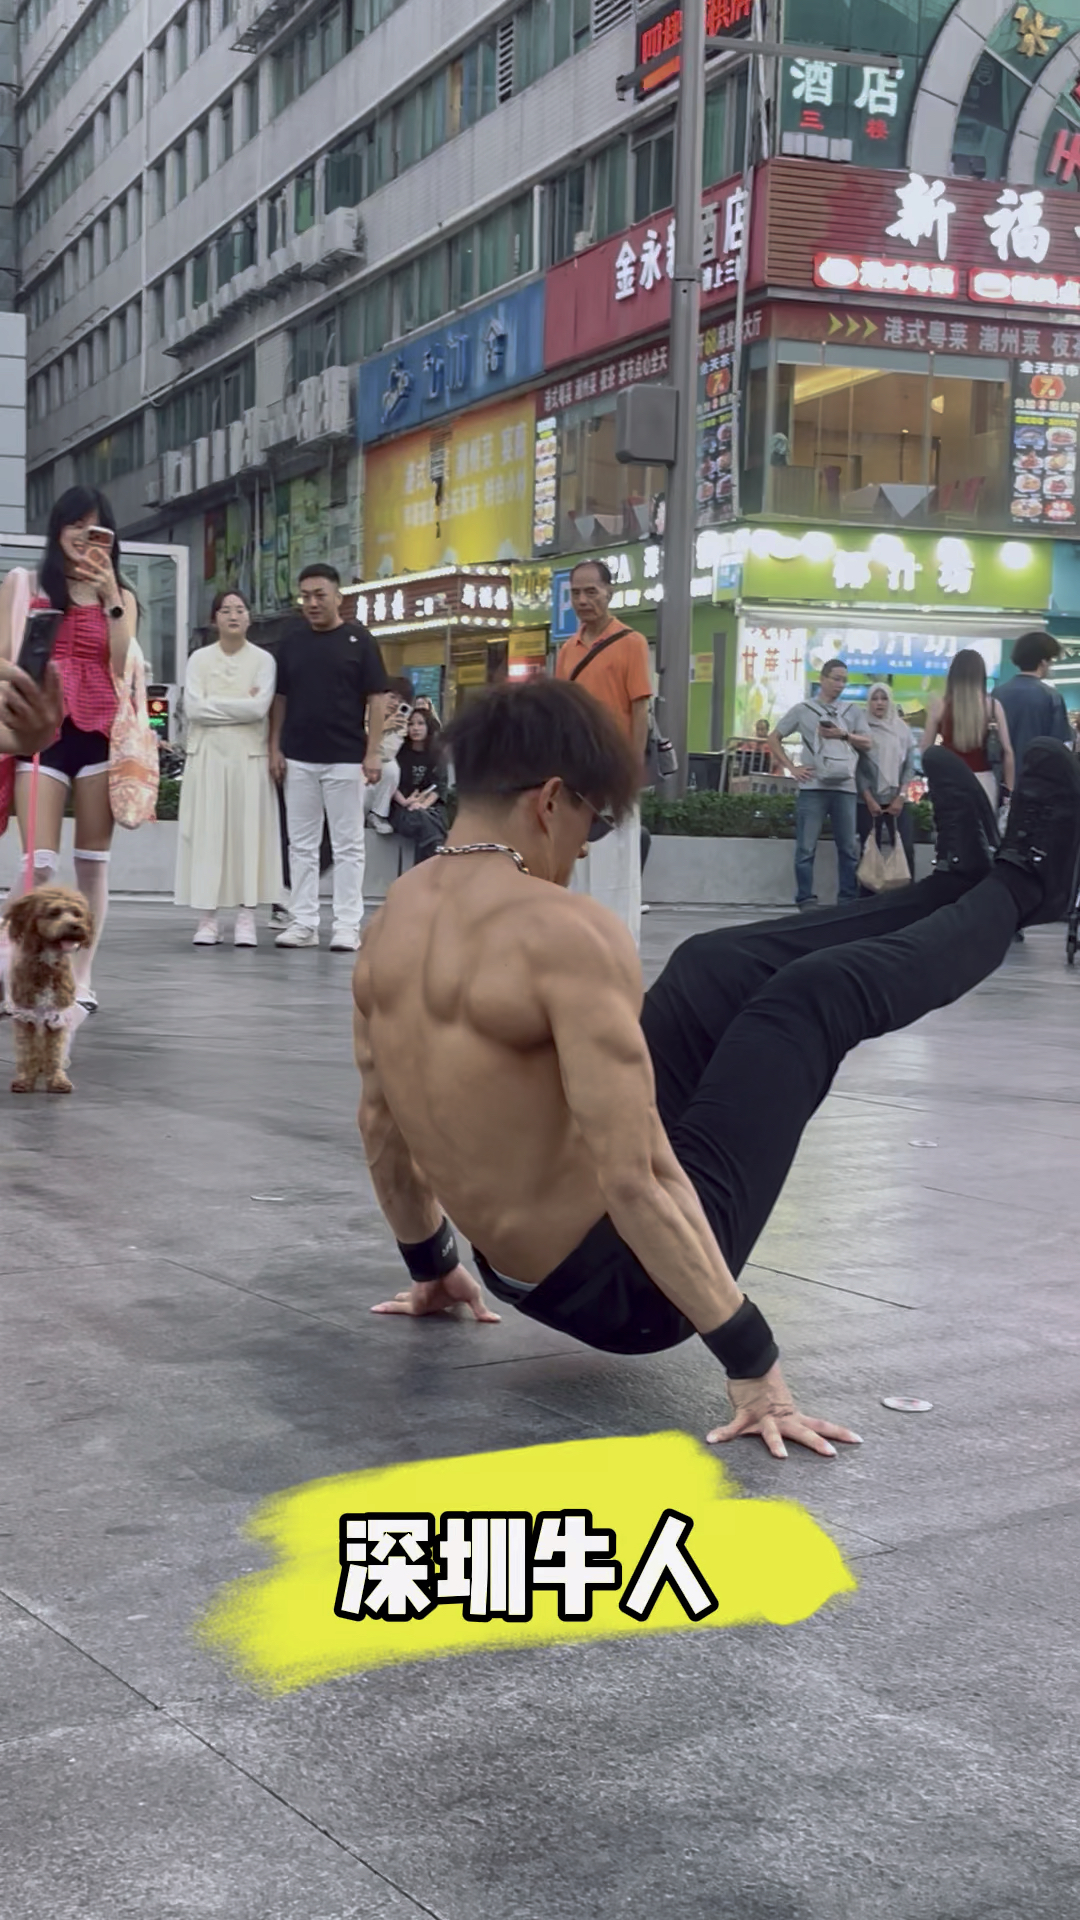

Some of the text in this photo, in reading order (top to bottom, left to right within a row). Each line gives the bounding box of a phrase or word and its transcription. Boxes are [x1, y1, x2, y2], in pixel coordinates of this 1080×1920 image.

[790, 57, 905, 117] 酒店
[885, 172, 1080, 263] 新福
[883, 315, 970, 351] 港式粤菜
[978, 324, 1042, 356] 潮州菜
